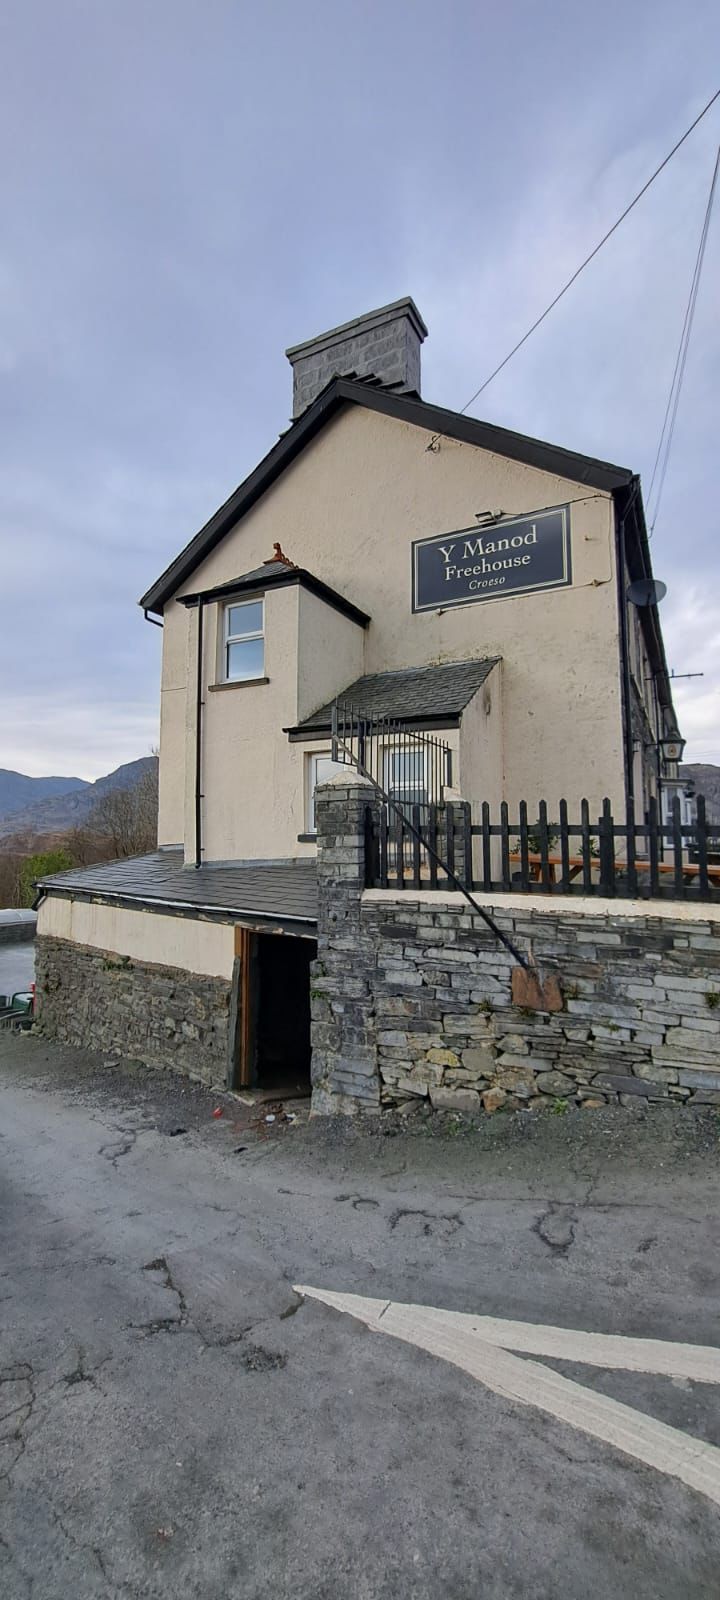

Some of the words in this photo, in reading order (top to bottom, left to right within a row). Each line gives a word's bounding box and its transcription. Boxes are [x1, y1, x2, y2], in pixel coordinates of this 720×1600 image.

[438, 544, 456, 564] Y
[461, 524, 538, 560] Manod
[445, 554, 531, 581] Freehouse
[469, 577, 506, 590] Croeso
